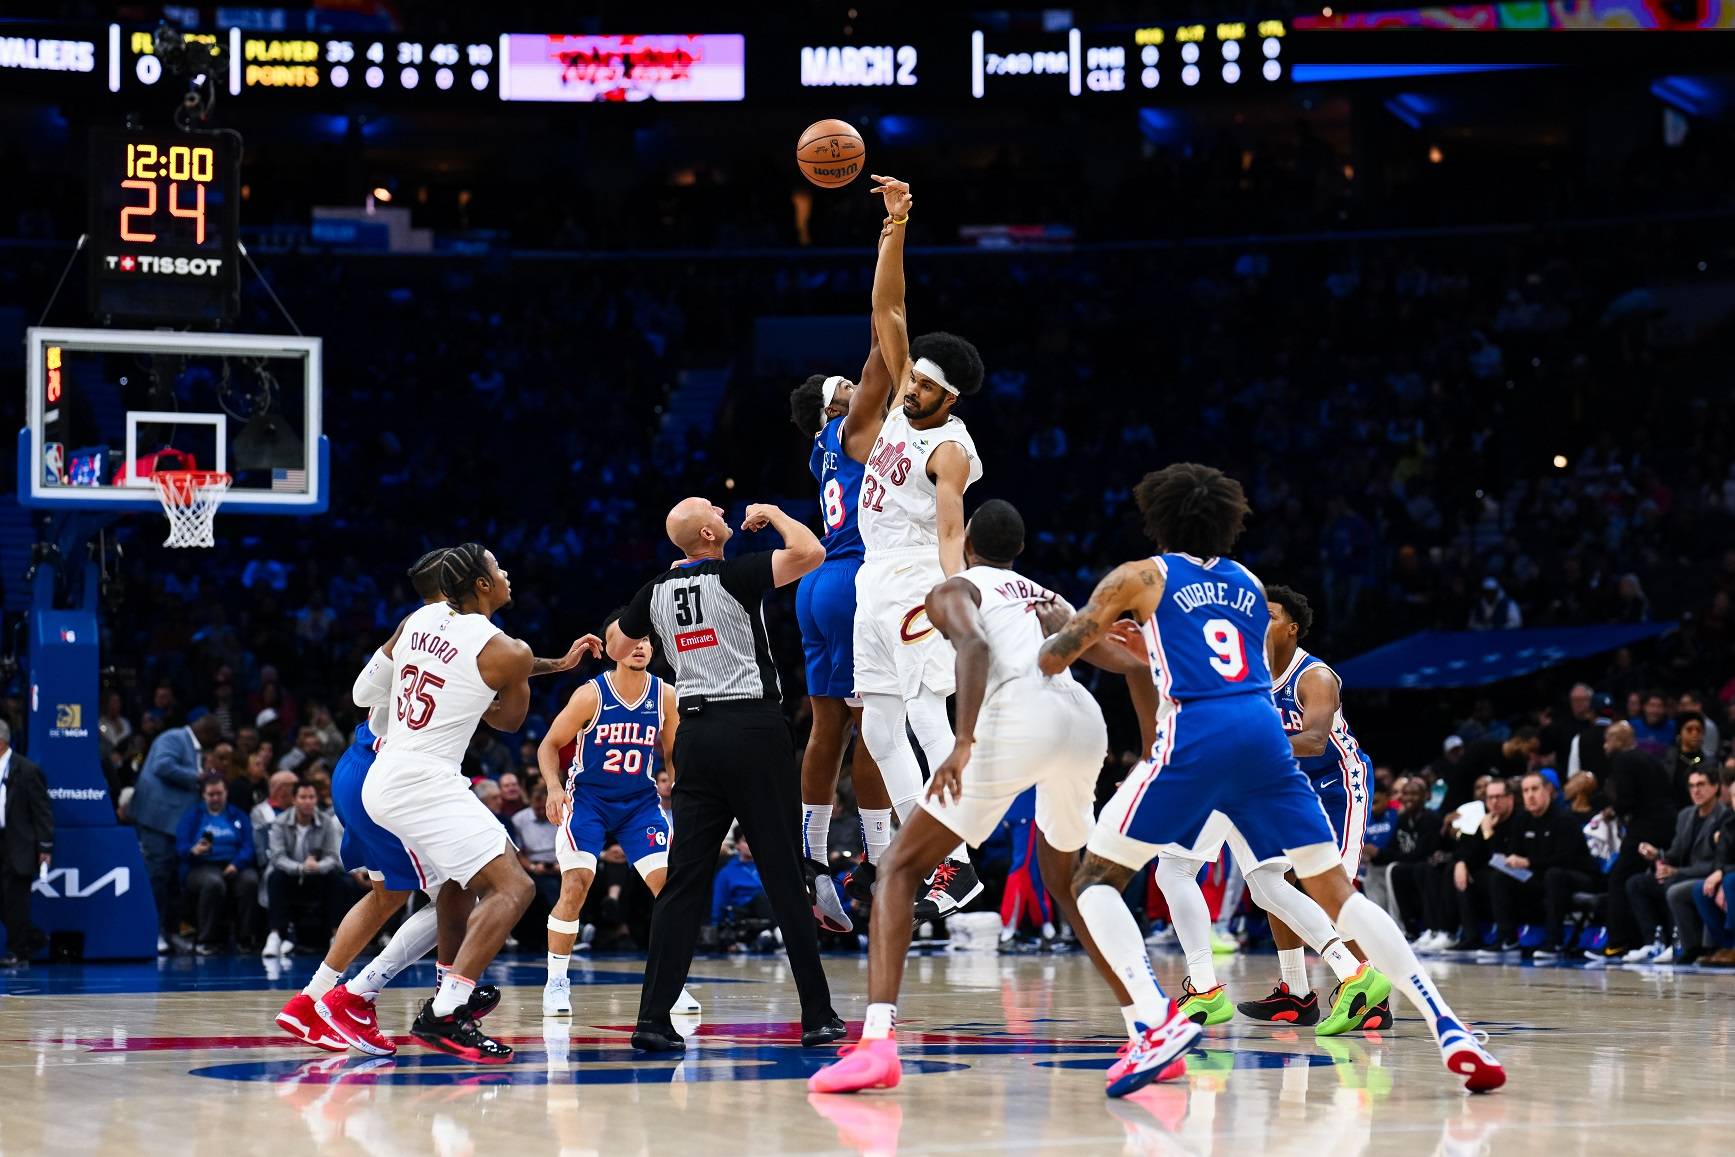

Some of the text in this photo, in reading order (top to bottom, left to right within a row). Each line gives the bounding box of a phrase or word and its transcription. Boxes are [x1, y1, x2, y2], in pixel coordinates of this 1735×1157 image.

[245, 39, 319, 61] PLAYER
[801, 45, 918, 86] MARCH 2
[246, 65, 319, 87] POINTS
[127, 143, 214, 182] 12:00
[120, 180, 205, 245] 24
[137, 255, 223, 277] TISSOT
[862, 474, 887, 513] 31
[674, 585, 704, 627] 37
[1172, 581, 1228, 614] OUBRE
[411, 631, 459, 665] OKORO
[680, 634, 714, 647] Emirates
[1202, 618, 1250, 682] 9
[397, 664, 446, 731] 35
[594, 722, 657, 747] PHILA
[603, 748, 643, 775] 20
